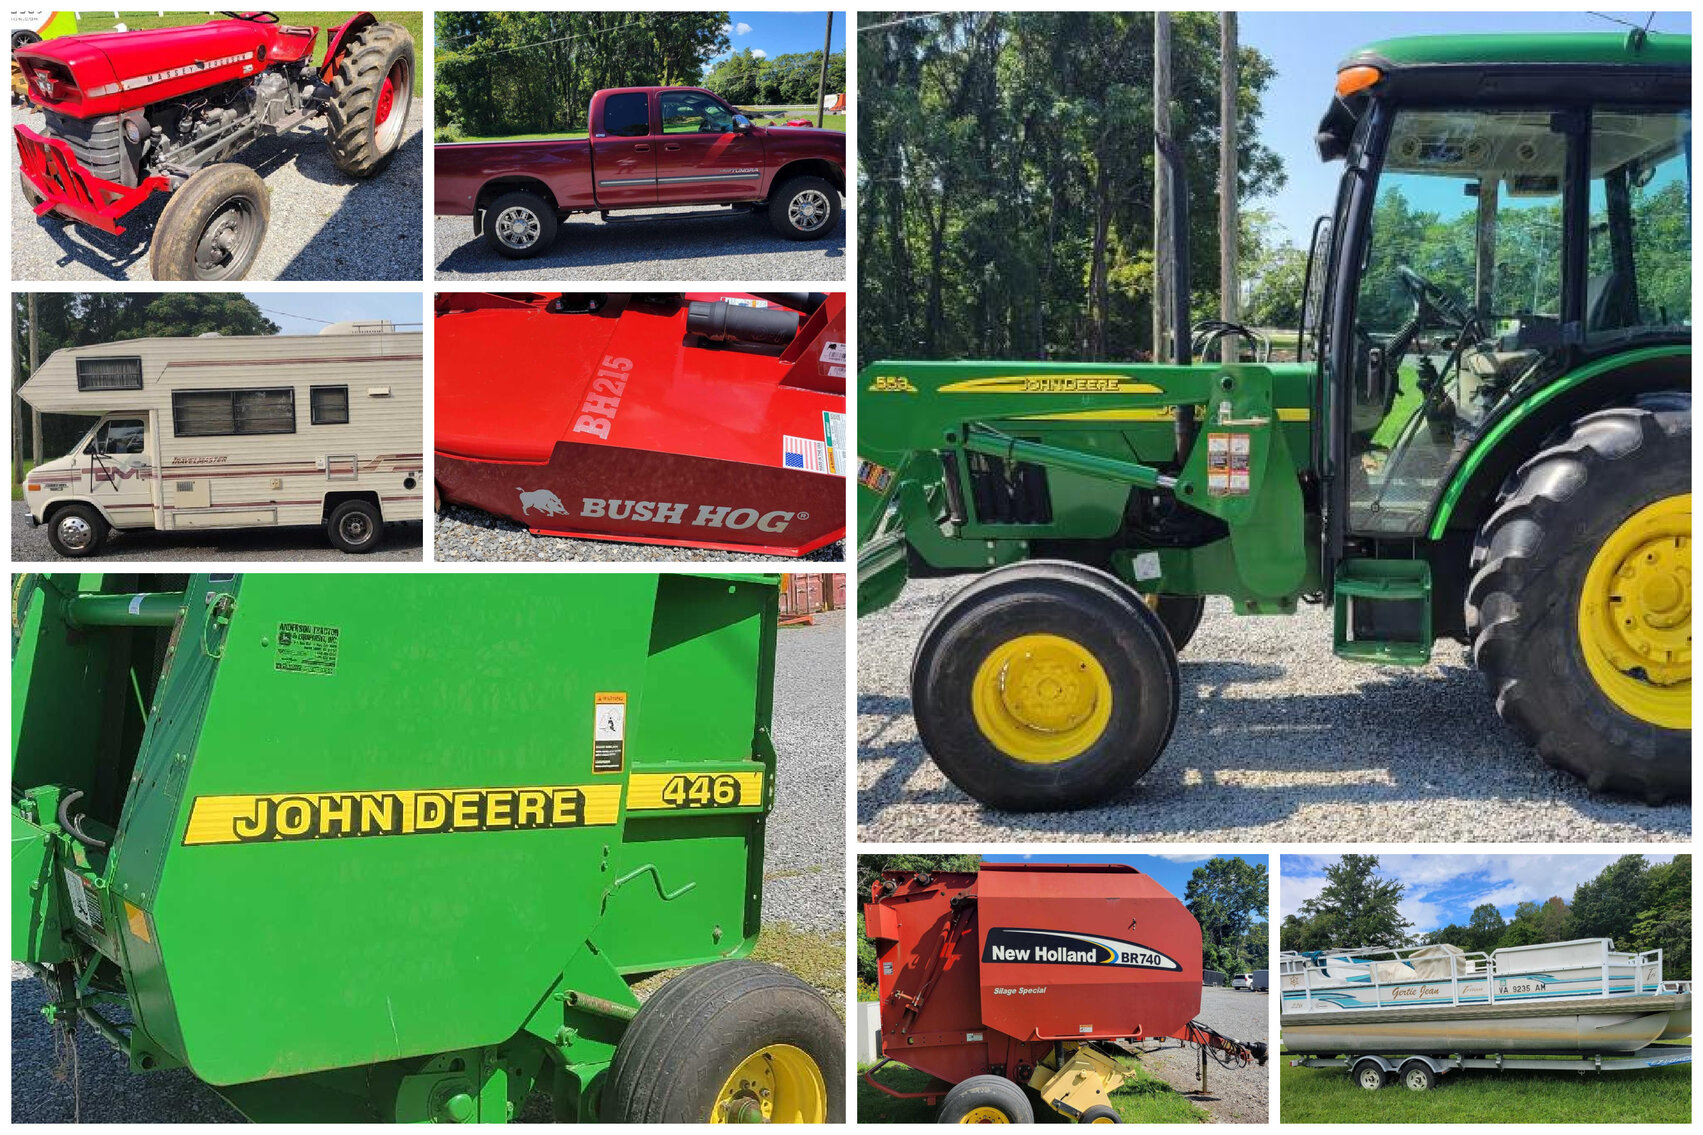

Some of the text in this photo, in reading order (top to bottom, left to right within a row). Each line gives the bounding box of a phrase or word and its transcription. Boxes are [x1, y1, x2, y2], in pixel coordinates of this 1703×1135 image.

[147, 65, 193, 83] MASSEY
[573, 354, 634, 440] BH215
[580, 498, 689, 524] BUSH
[661, 775, 738, 807] 446
[233, 787, 583, 841] JOHN DEERE
[992, 945, 1097, 963] New Holland
[1121, 952, 1161, 966] BR740
[993, 986, 1046, 996] Silage Special
[1391, 984, 1440, 1000] Gertie Jean
[1499, 982, 1547, 994] VA 9235 AM
